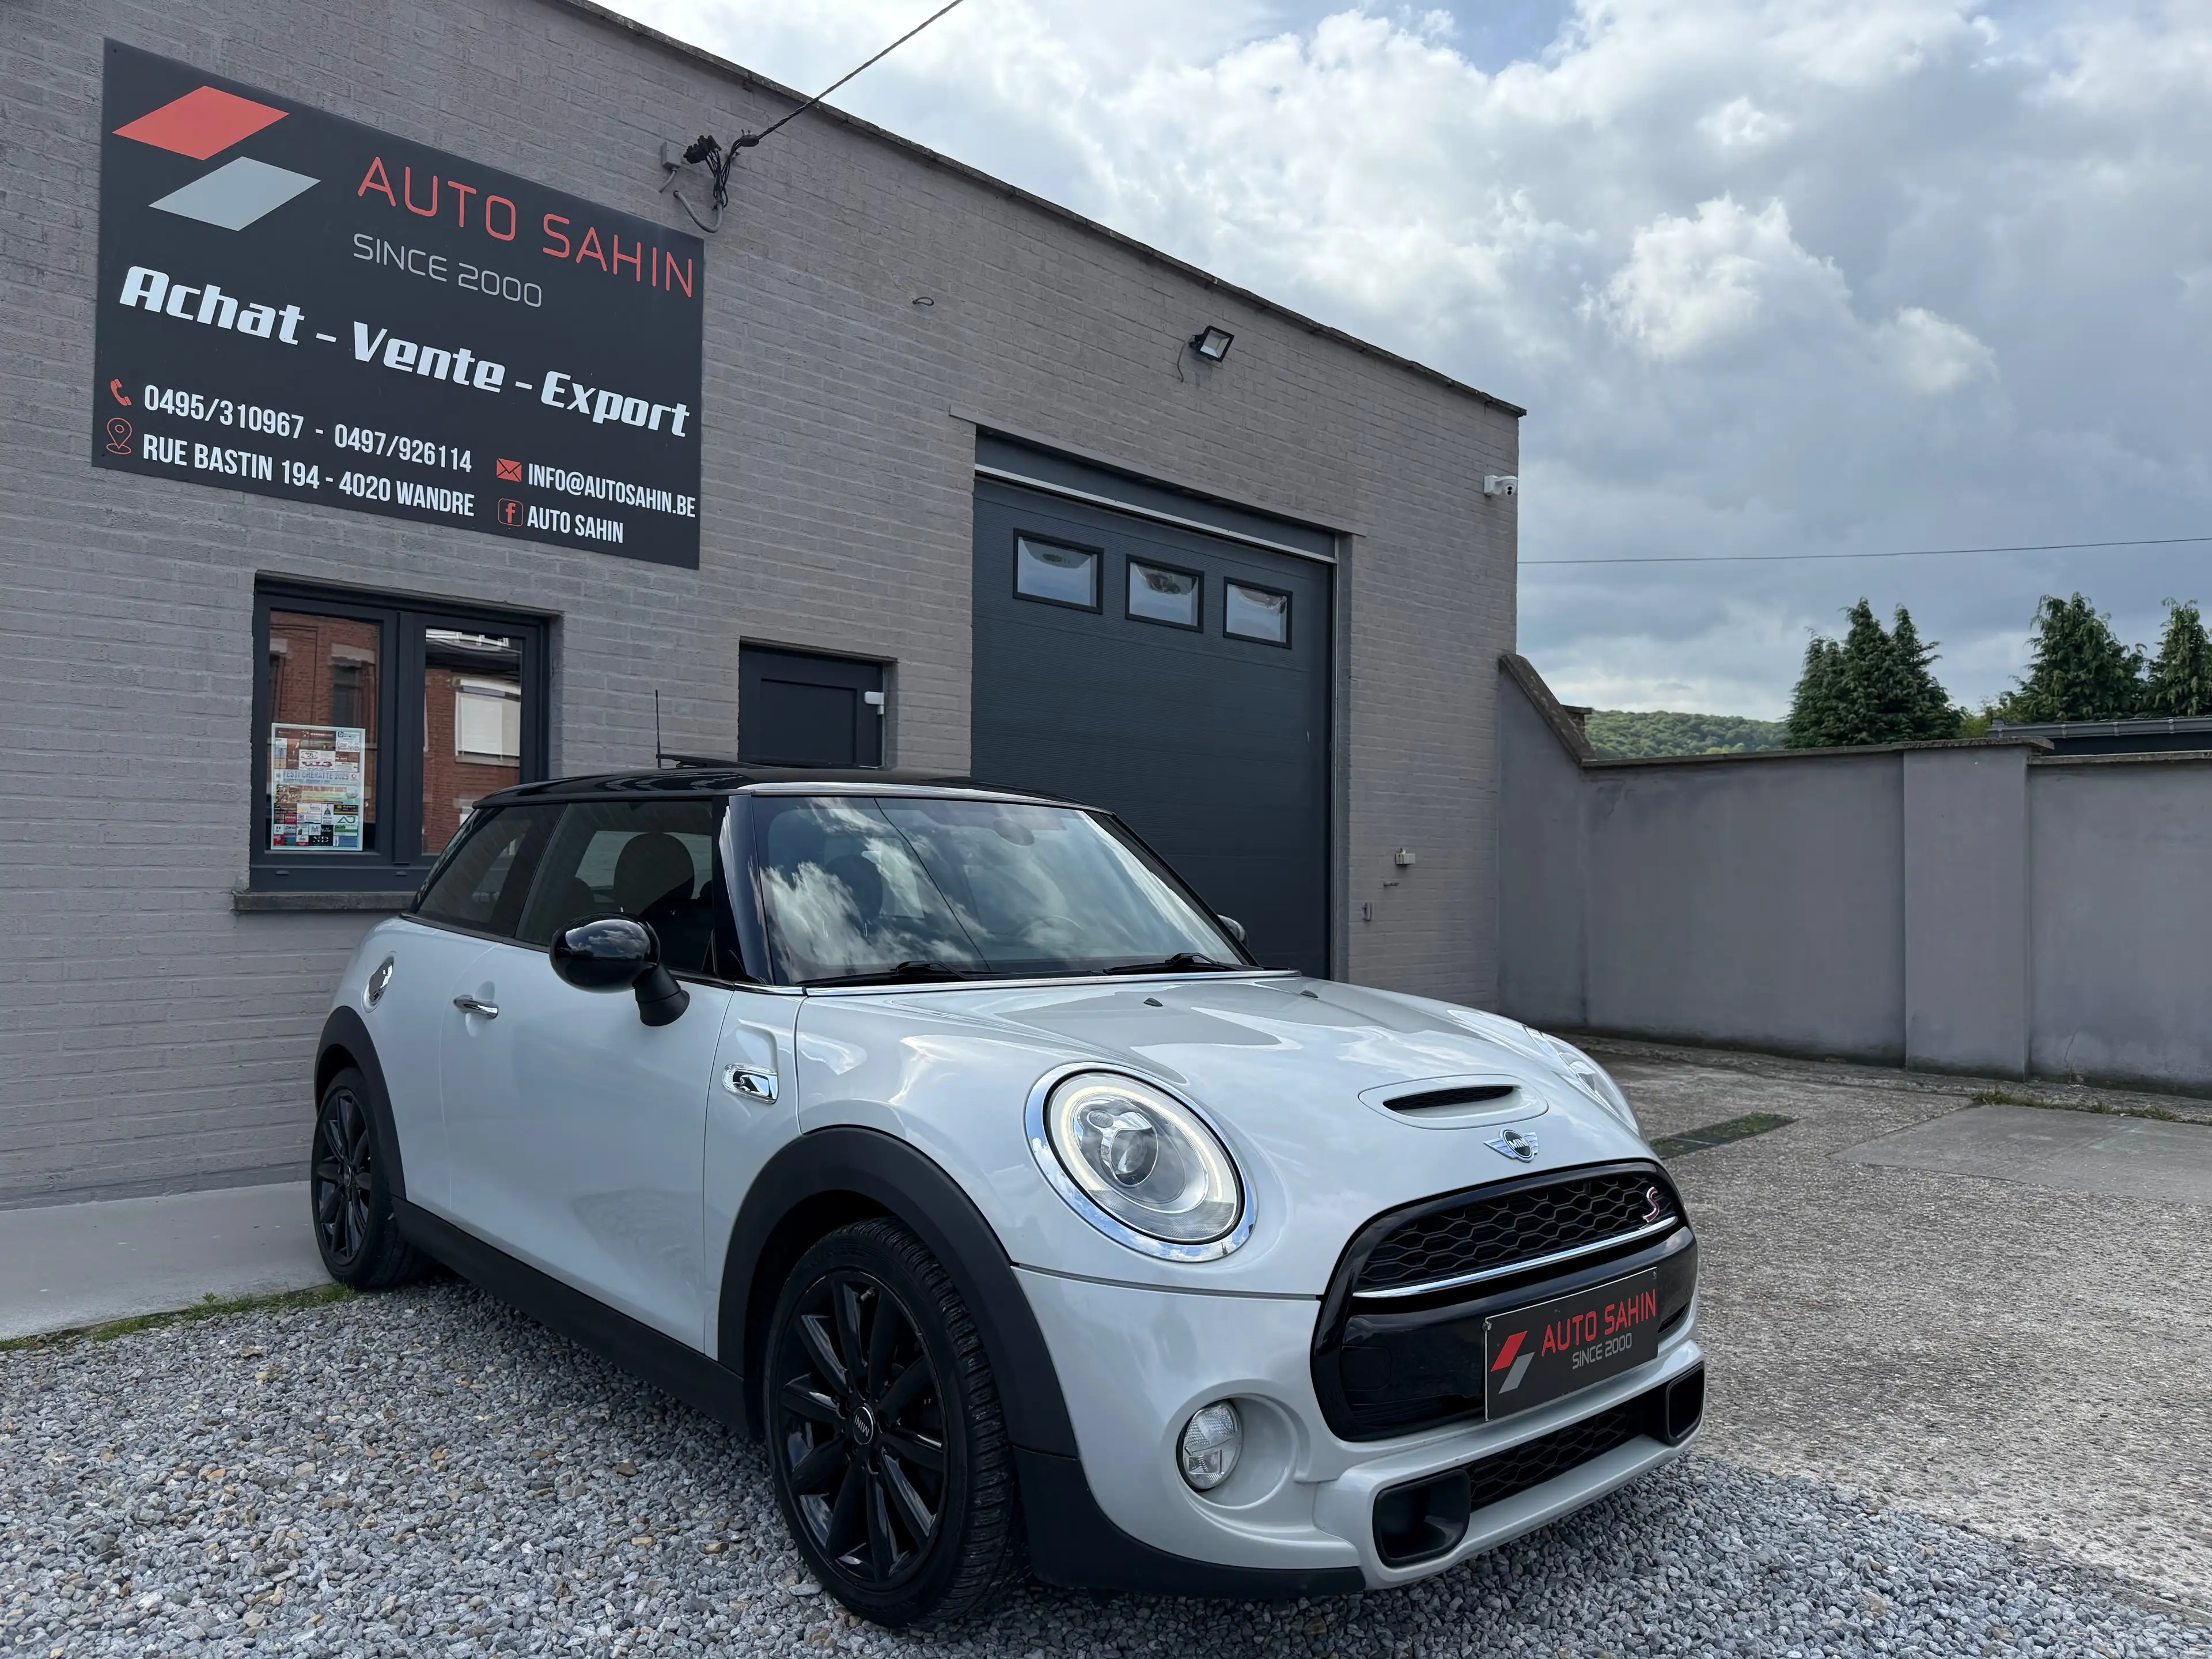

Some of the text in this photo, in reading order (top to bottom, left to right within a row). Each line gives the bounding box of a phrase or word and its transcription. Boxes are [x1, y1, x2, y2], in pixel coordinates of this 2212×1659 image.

[358, 157, 692, 297] AUTO SAHIN
[354, 233, 542, 308] SINCE 2000
[119, 266, 305, 346] Achat
[354, 321, 506, 393] Vente
[540, 370, 690, 437] Export
[144, 385, 304, 439] 0495/310967
[335, 423, 472, 473] 0497/926114
[143, 433, 188, 466] RUE
[194, 443, 272, 481] BASTIN
[282, 460, 320, 489] 194
[339, 471, 391, 502] 4020
[396, 480, 475, 517] WANDRE
[528, 463, 696, 518] INFO@AUTOSAHIN.BE
[527, 505, 624, 544] AUTO SAHIN
[1508, 1137, 1529, 1149] MINI
[1541, 1289, 1657, 1357] AUTO SAHIN
[1572, 1332, 1633, 1370] SINCE 2000
[854, 1415, 870, 1437] MINI
